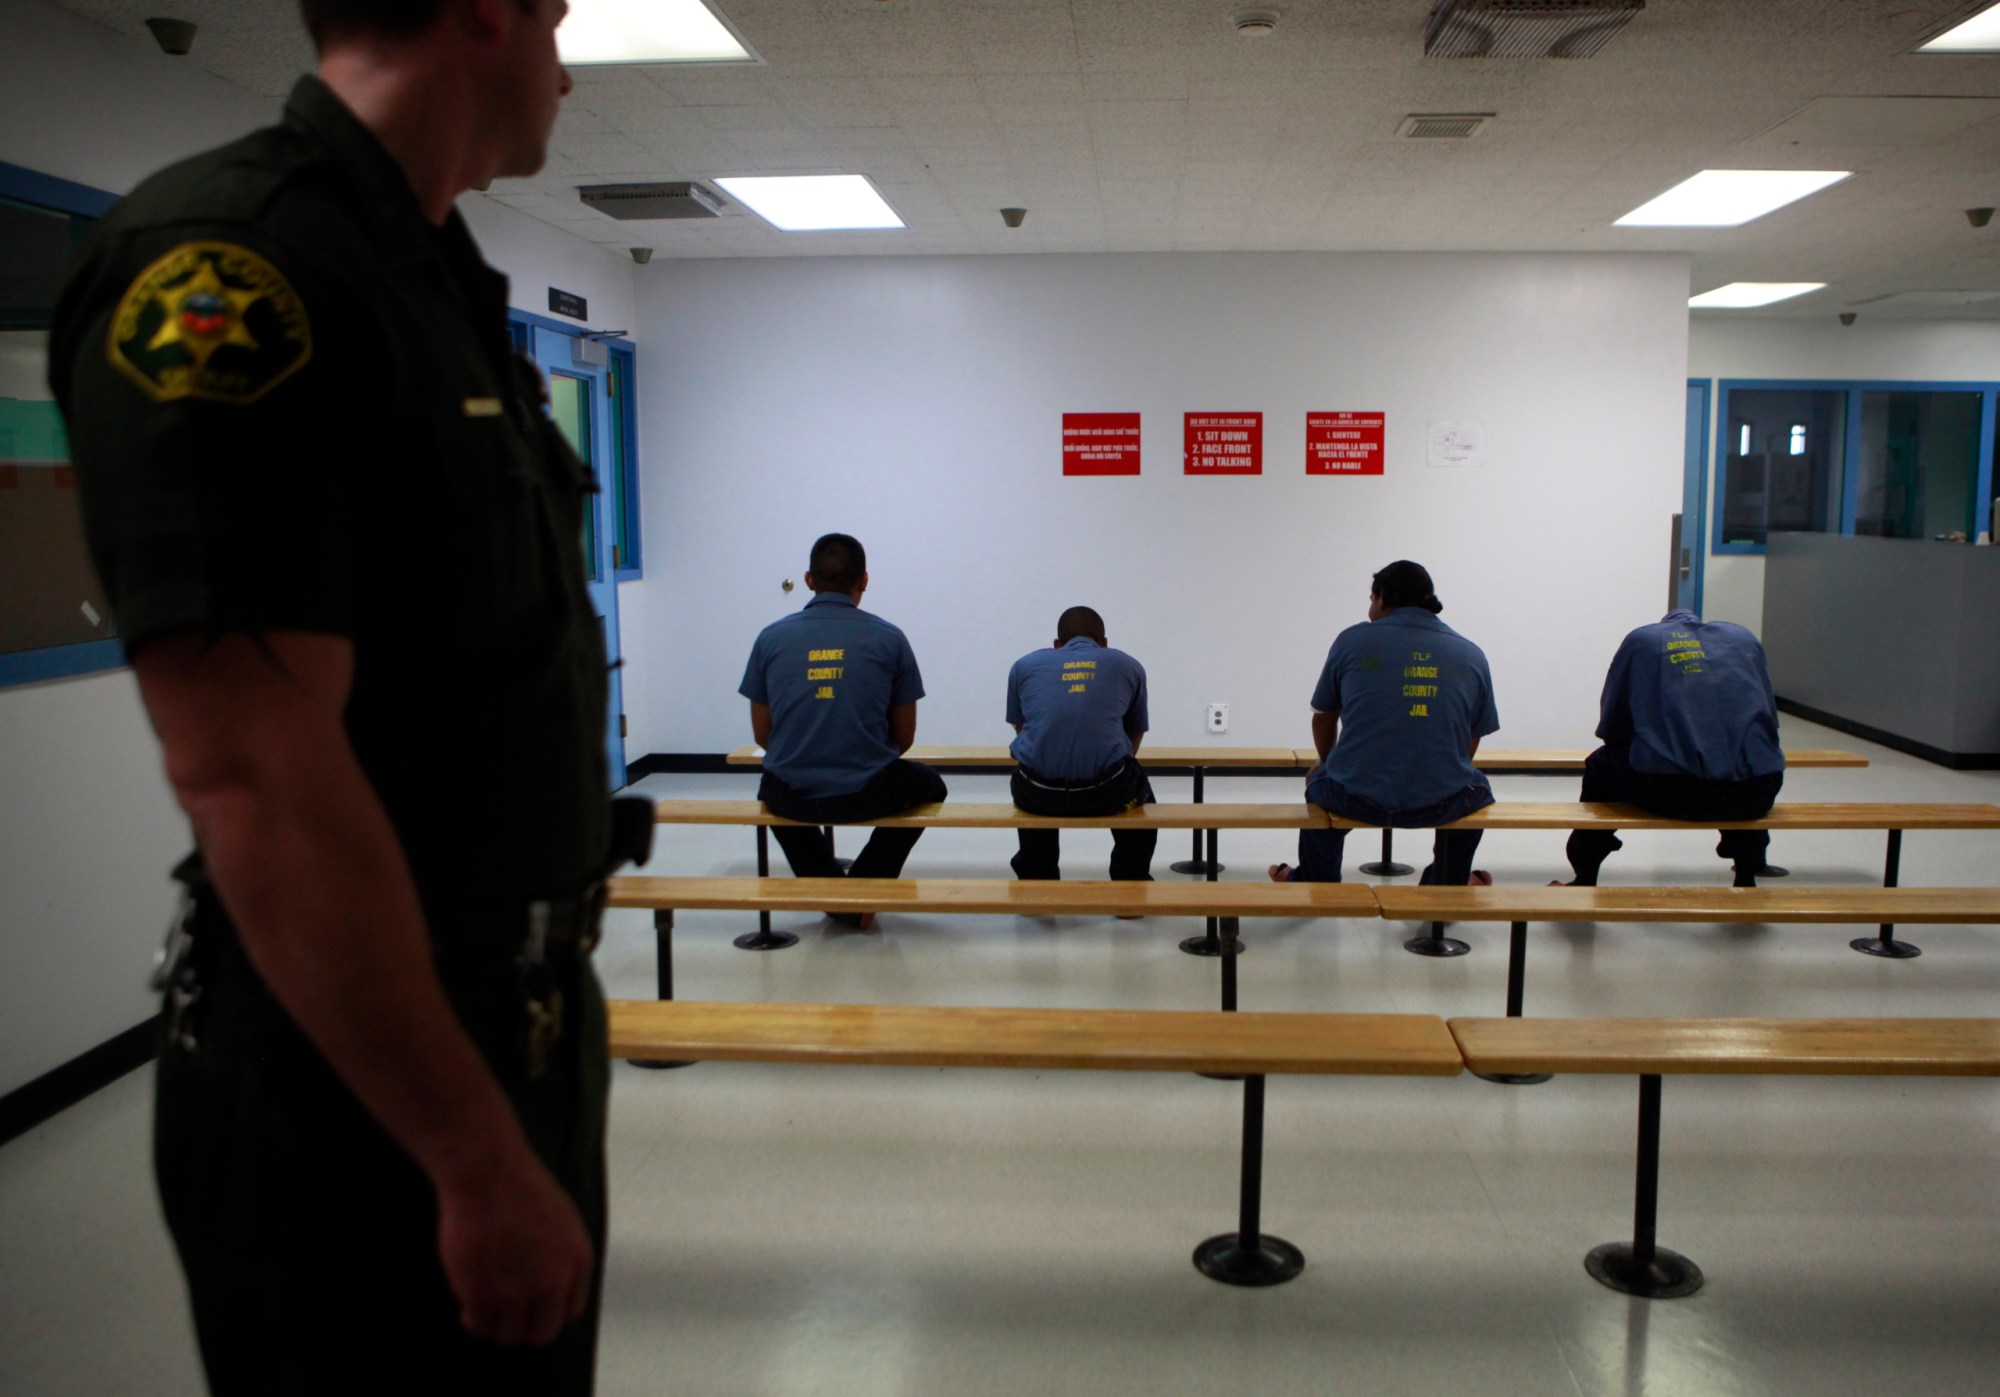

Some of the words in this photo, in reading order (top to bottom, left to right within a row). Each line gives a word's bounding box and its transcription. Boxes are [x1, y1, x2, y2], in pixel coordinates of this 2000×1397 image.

[1197, 431, 1203, 441] 1.
[1205, 431, 1219, 441] SIT
[1221, 431, 1248, 441] DOWN
[1192, 444, 1200, 454] 2.
[1202, 444, 1222, 454] FACE
[1224, 444, 1252, 454] FRONT
[1315, 442, 1350, 451] MANTENGA
[1351, 442, 1358, 451] LA
[1359, 442, 1378, 451] VISTA
[1339, 450, 1345, 458] EL
[1346, 450, 1368, 458] FRENTE
[1192, 457, 1200, 467] 3.
[1202, 457, 1214, 467] NO
[1216, 457, 1252, 467] TALKING
[807, 667, 844, 680] COUNTY
[1404, 666, 1439, 678] ORANGE
[1402, 684, 1438, 697] COUNTY
